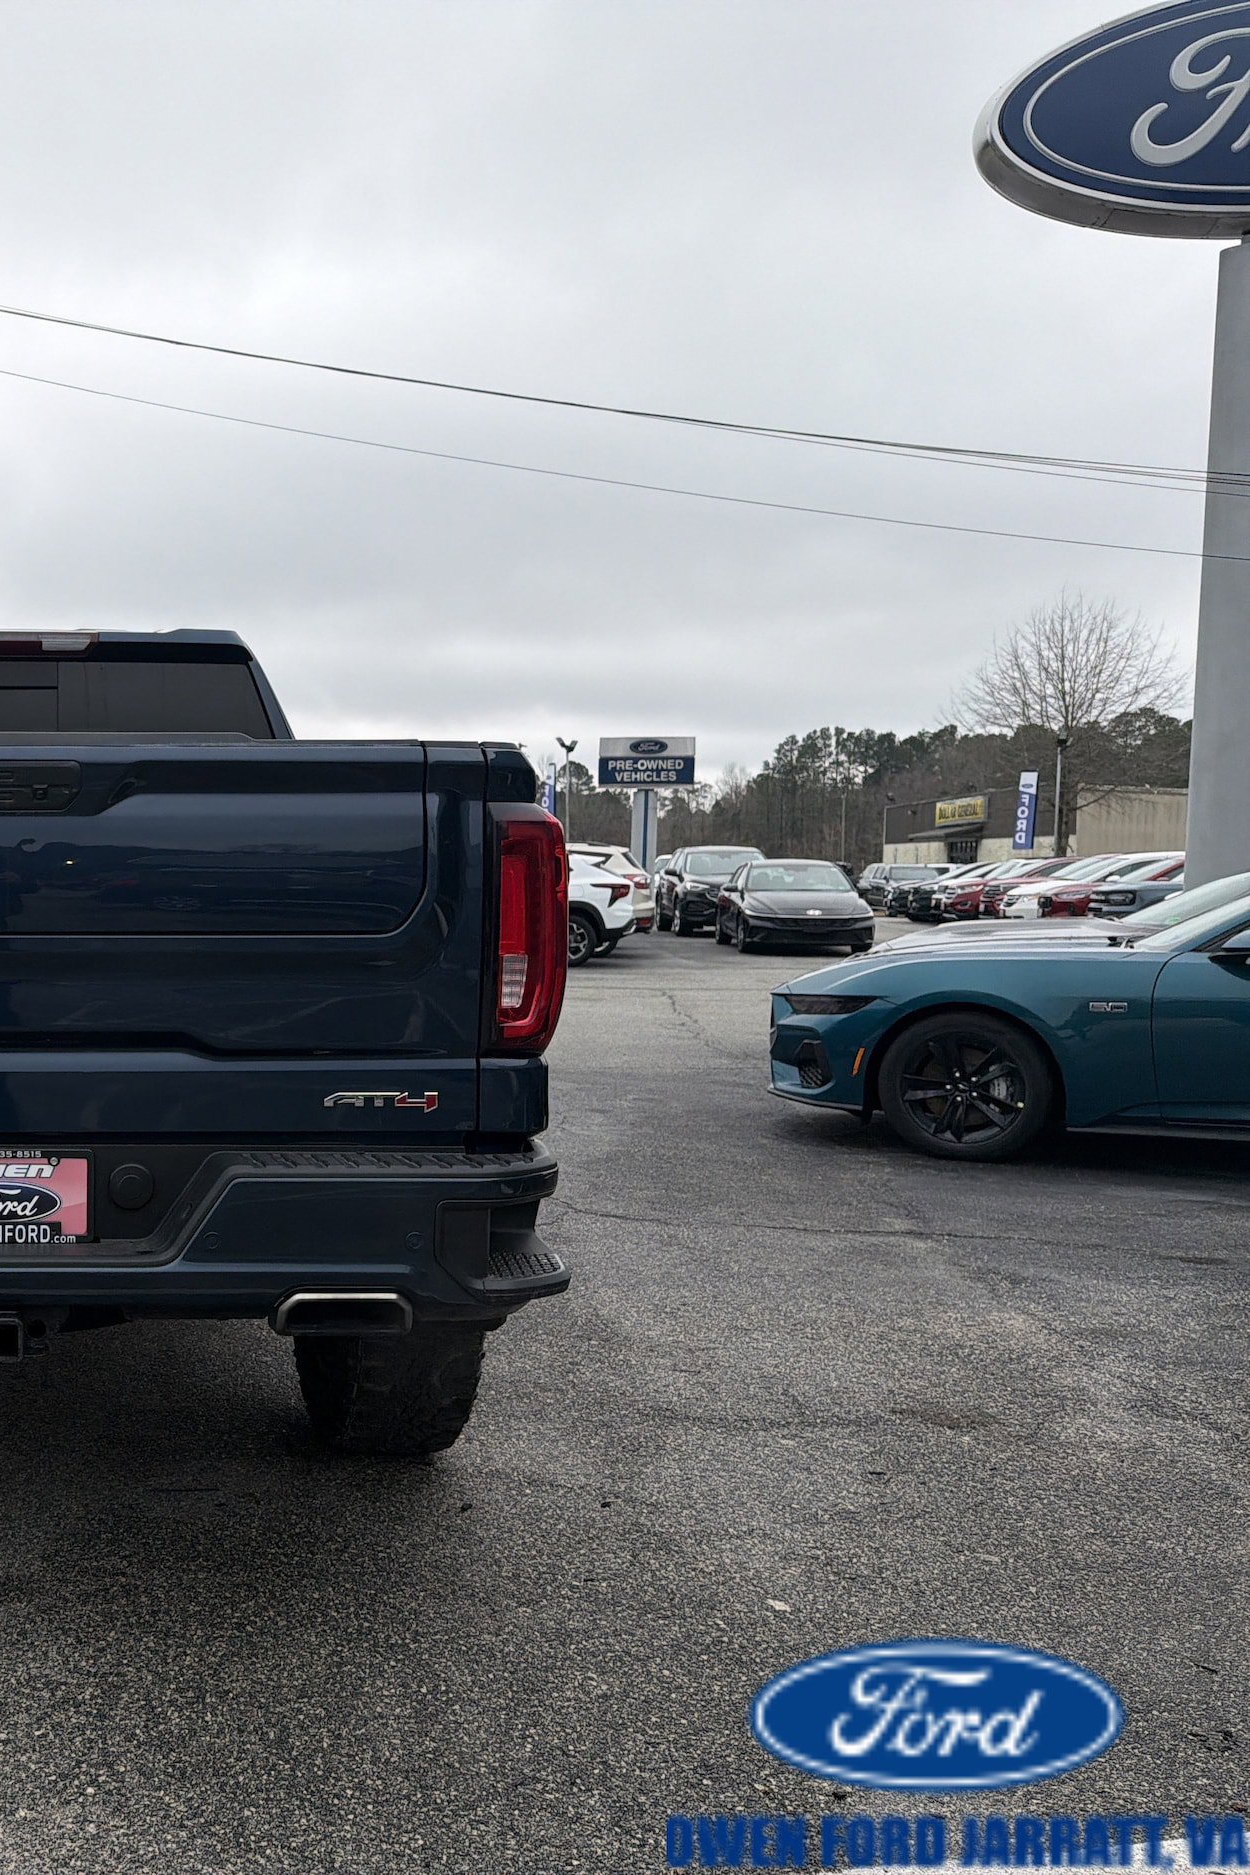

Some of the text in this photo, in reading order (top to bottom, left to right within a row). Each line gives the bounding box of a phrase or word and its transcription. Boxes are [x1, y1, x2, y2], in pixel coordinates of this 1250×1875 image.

[608, 759, 684, 770] PRE-OWNED
[615, 771, 677, 782] VEHICLES
[324, 1091, 439, 1113] AT4
